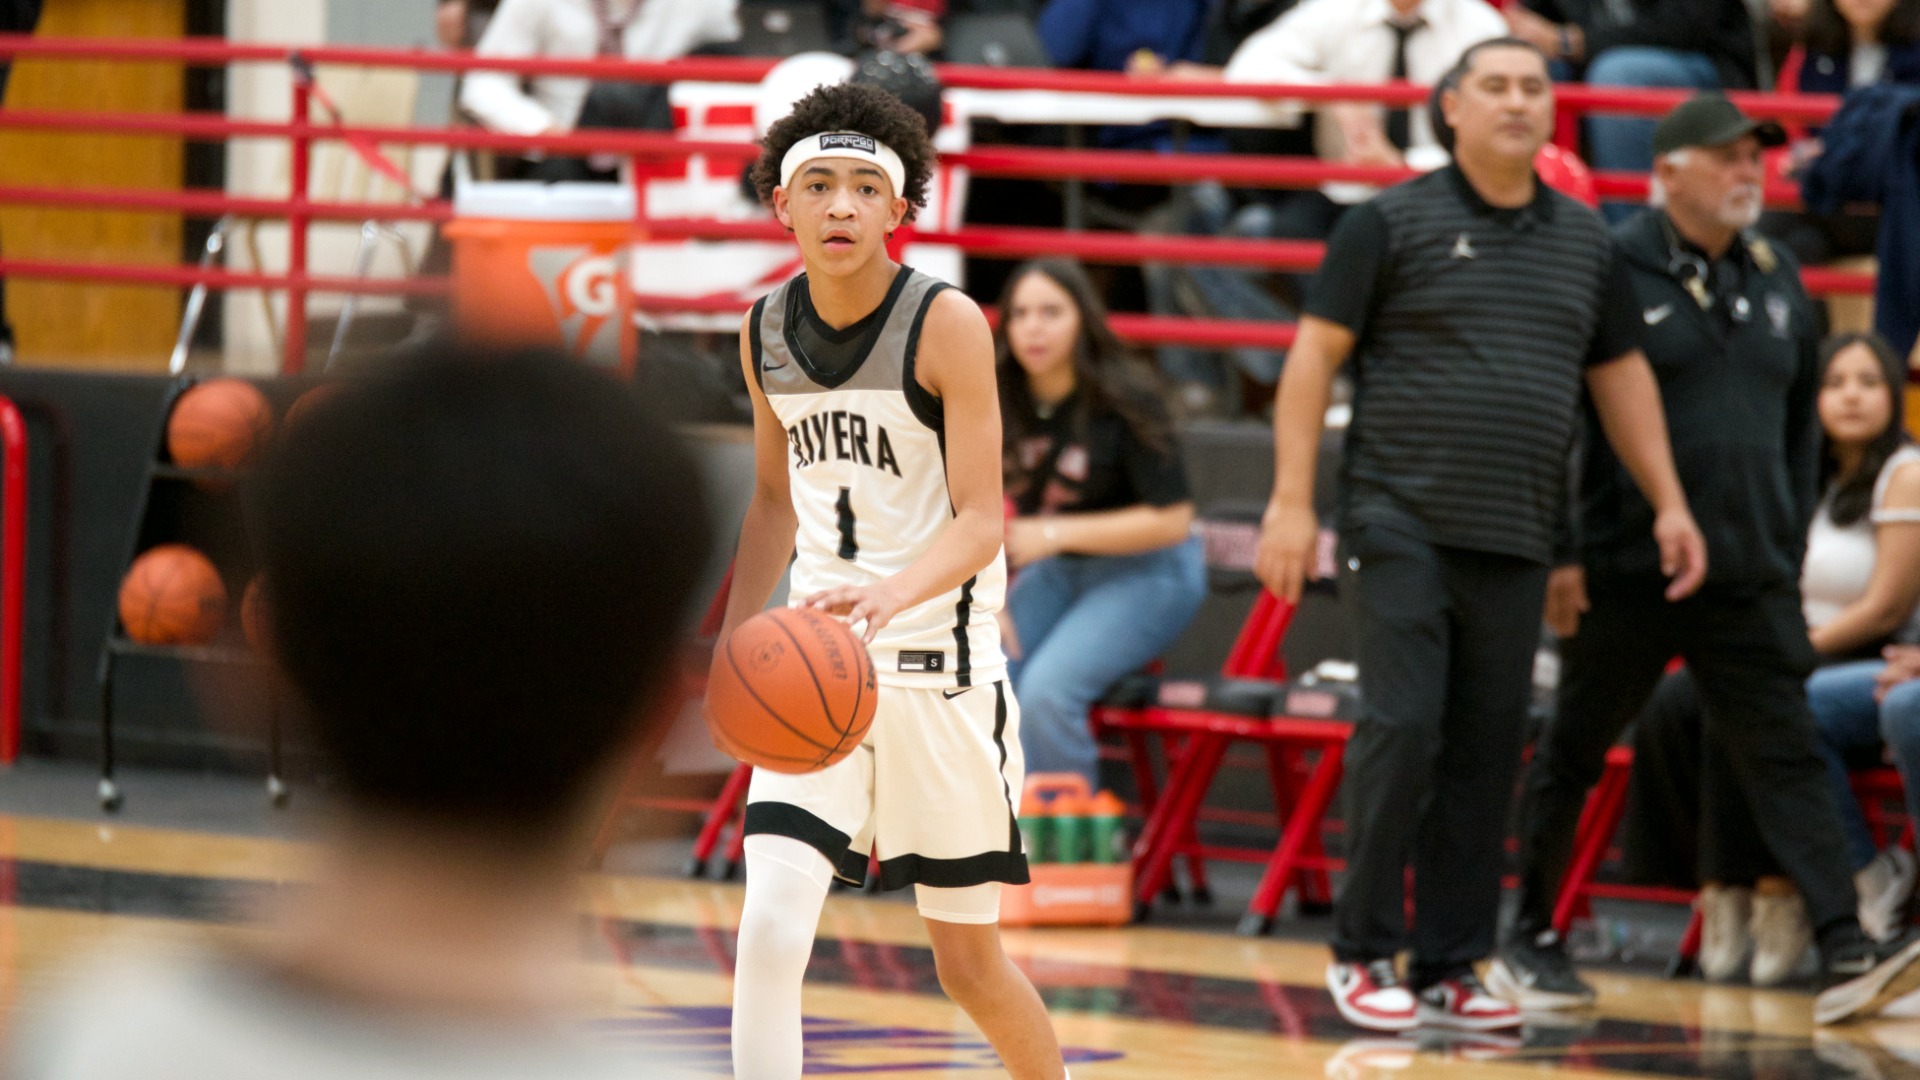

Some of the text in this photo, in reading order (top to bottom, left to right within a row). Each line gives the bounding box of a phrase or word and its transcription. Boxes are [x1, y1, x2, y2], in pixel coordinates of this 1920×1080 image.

[567, 258, 616, 315] G
[834, 486, 860, 562] 1
[930, 658, 938, 668] S
